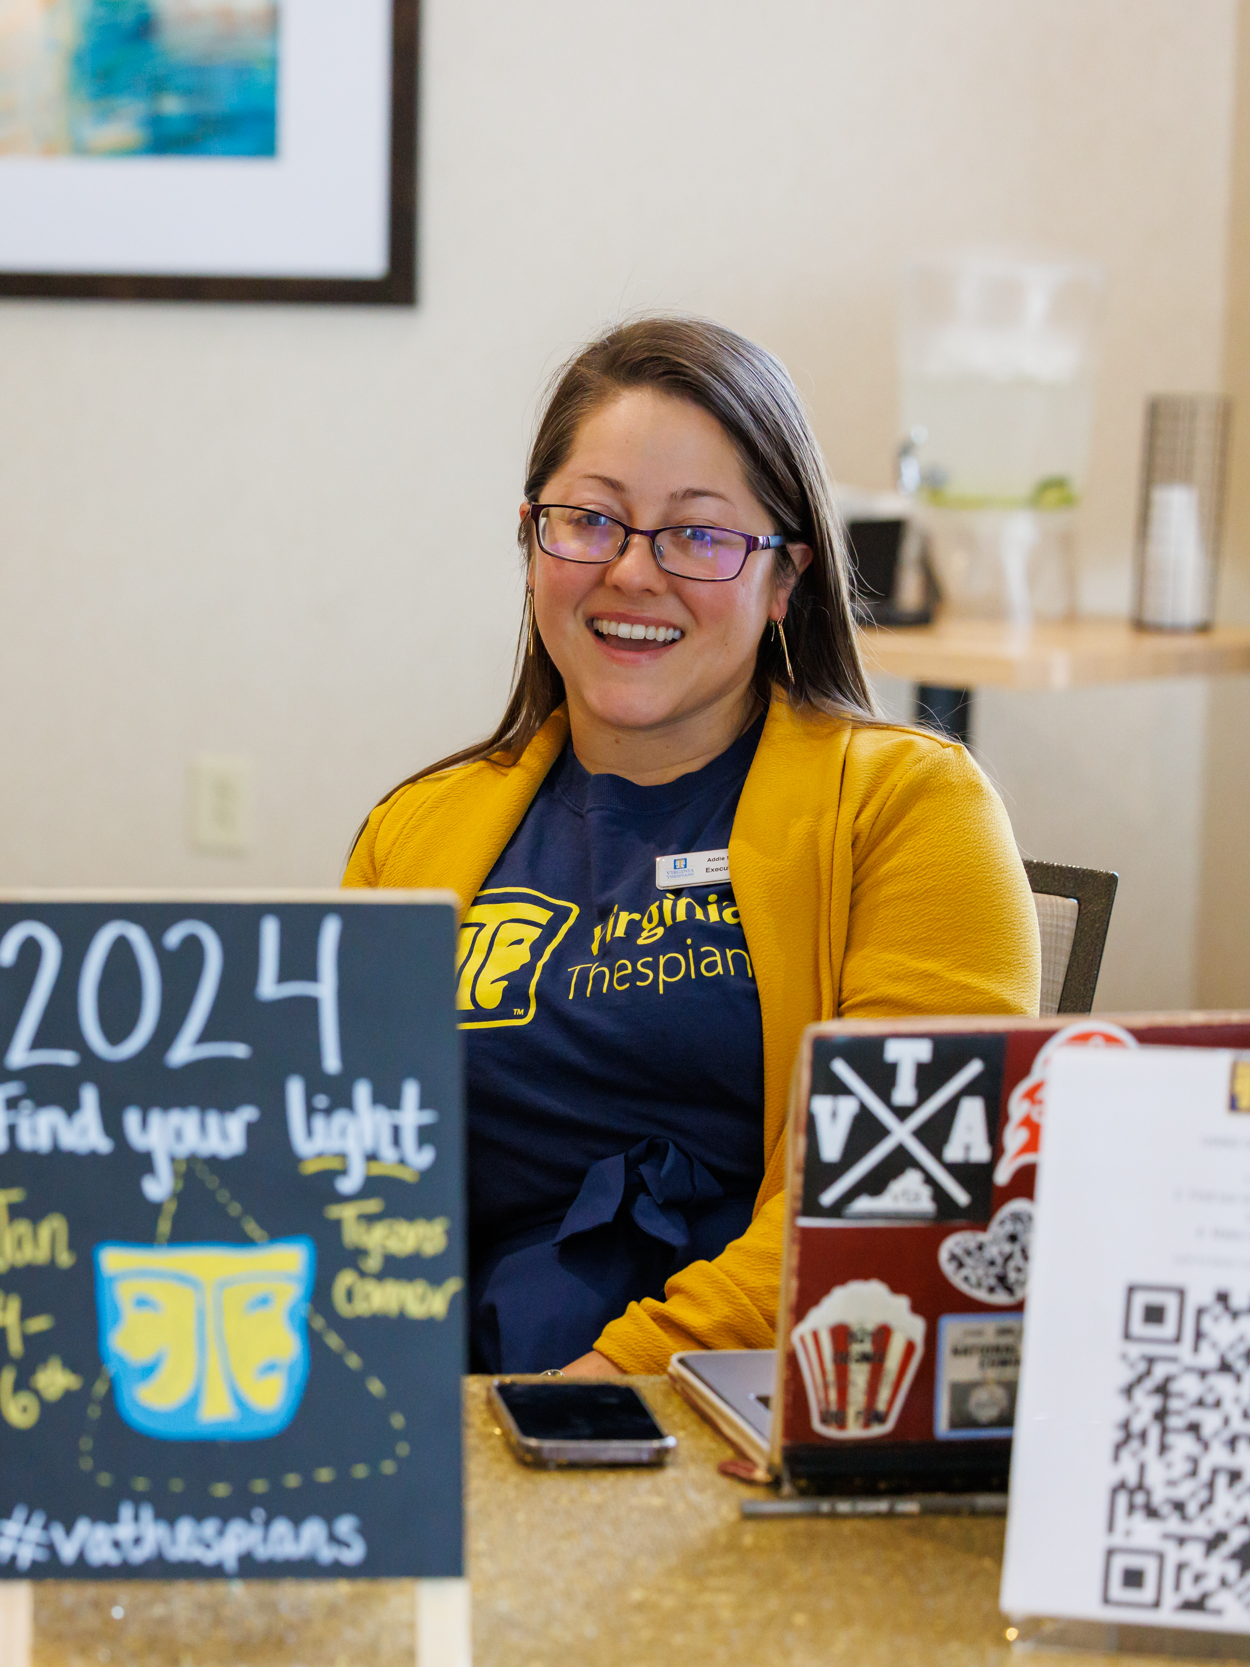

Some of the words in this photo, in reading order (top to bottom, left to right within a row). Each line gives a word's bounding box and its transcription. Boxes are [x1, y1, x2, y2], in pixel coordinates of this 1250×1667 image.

[705, 866, 729, 874] Execu
[591, 892, 743, 957] Virginia
[567, 937, 754, 1000] Thespian
[513, 1007, 525, 1016] TM
[122, 1104, 261, 1202] your
[284, 1074, 440, 1196] light
